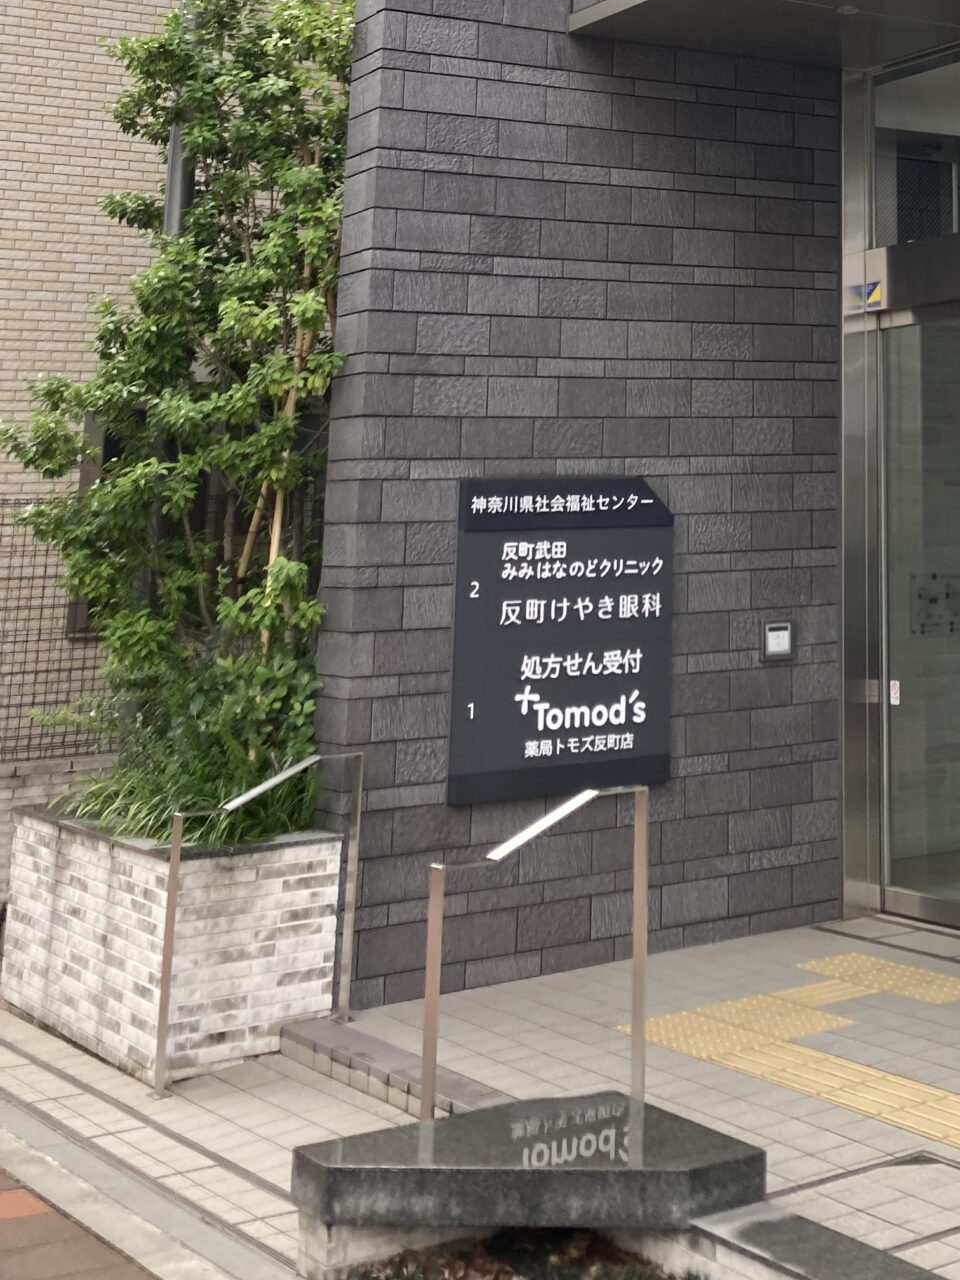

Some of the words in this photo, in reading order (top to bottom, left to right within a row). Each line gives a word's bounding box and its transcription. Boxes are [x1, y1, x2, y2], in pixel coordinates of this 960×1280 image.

[471, 494, 654, 514] 神奈川県社会福祉センター
[501, 541, 567, 561] 反町武田
[501, 557, 664, 580] みみはなのどクリニック
[469, 581, 480, 599] 2
[500, 592, 662, 626] 反町けやき眼科
[520, 648, 643, 681] 処方せん受付
[466, 702, 475, 720] 1
[533, 689, 647, 732] Tomod's
[524, 733, 634, 758] 薬局トモズ反町店
